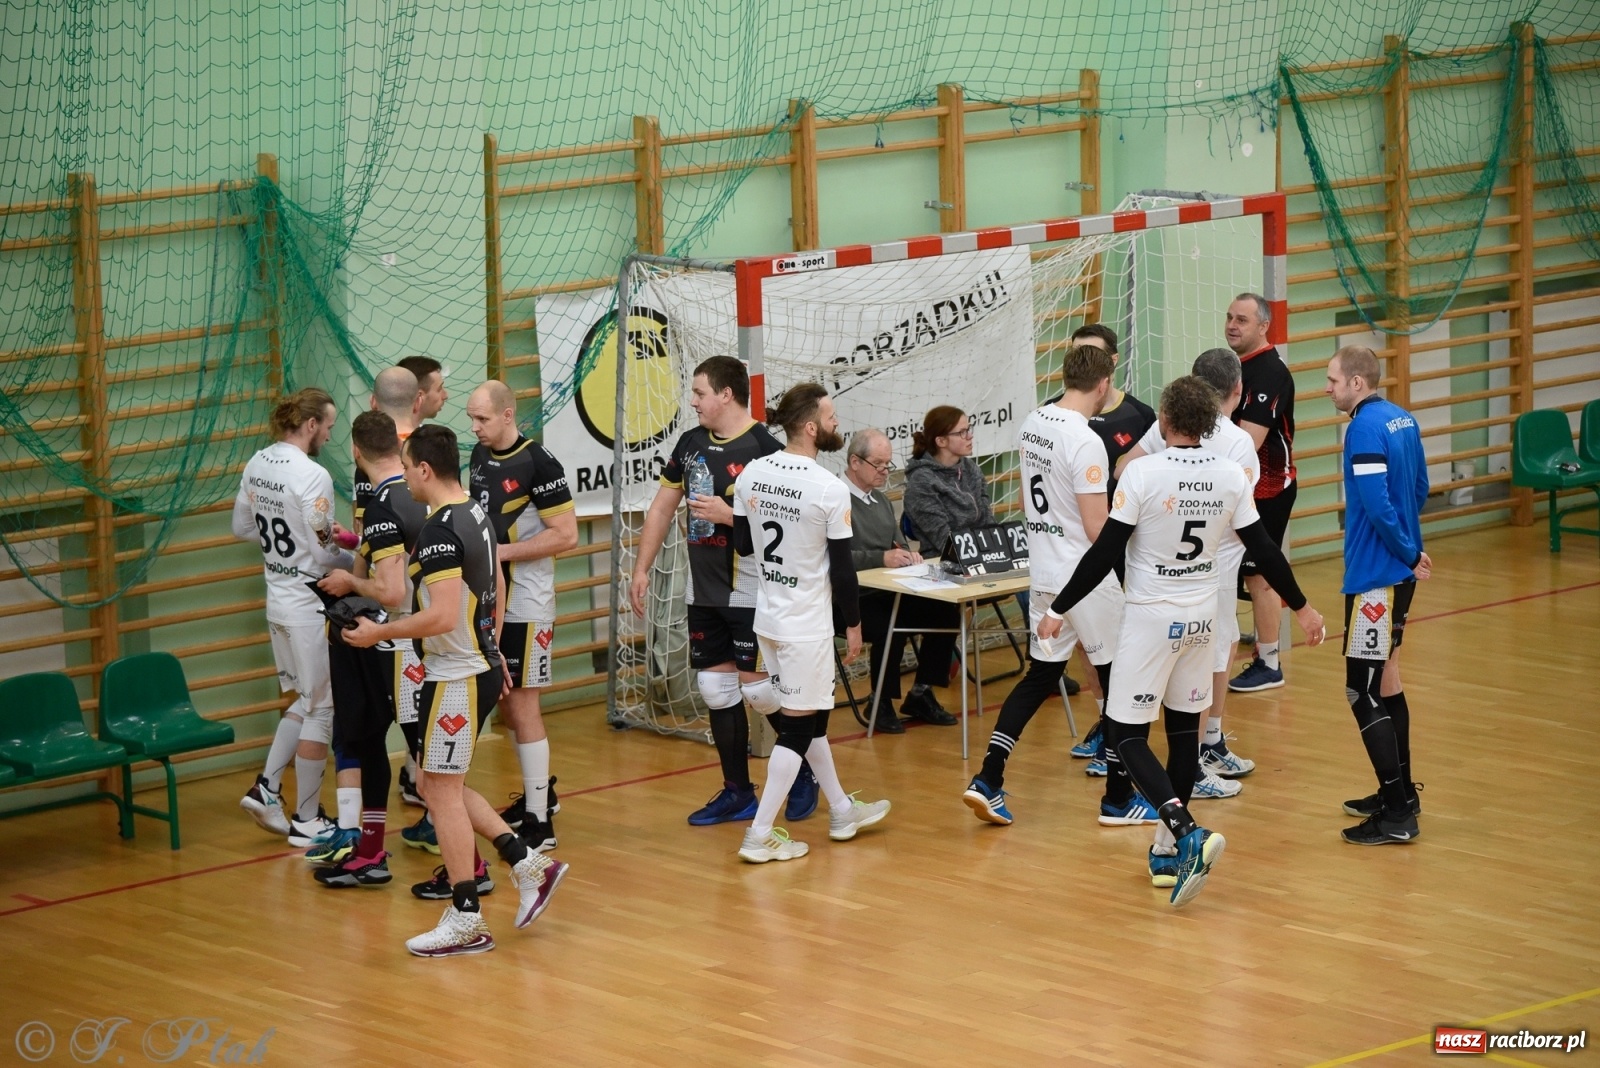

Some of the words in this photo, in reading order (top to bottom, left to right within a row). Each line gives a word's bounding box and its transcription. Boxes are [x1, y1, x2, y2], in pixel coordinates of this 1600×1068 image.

[802, 256, 825, 268] sport
[1021, 431, 1054, 451] SKORUPA
[249, 476, 285, 494] MICHALAK
[532, 477, 568, 495] GRAVTO
[751, 481, 802, 500] ZIELIŃSKI
[1030, 474, 1049, 515] 6
[1178, 482, 1213, 491] PYCIU
[480, 490, 490, 513] 2
[760, 508, 801, 523] LUNATYCY
[761, 520, 784, 565] 2
[955, 532, 978, 559] 23
[978, 530, 988, 548] 1
[993, 528, 1002, 546] 1
[1007, 525, 1029, 553] 25
[1175, 520, 1207, 561] 5
[982, 551, 1006, 562] JOOLA
[1187, 619, 1213, 636] DK
[1171, 634, 1211, 654] glass
[1365, 628, 1379, 649] 3
[539, 655, 548, 677] 2
[444, 741, 456, 763] 7
